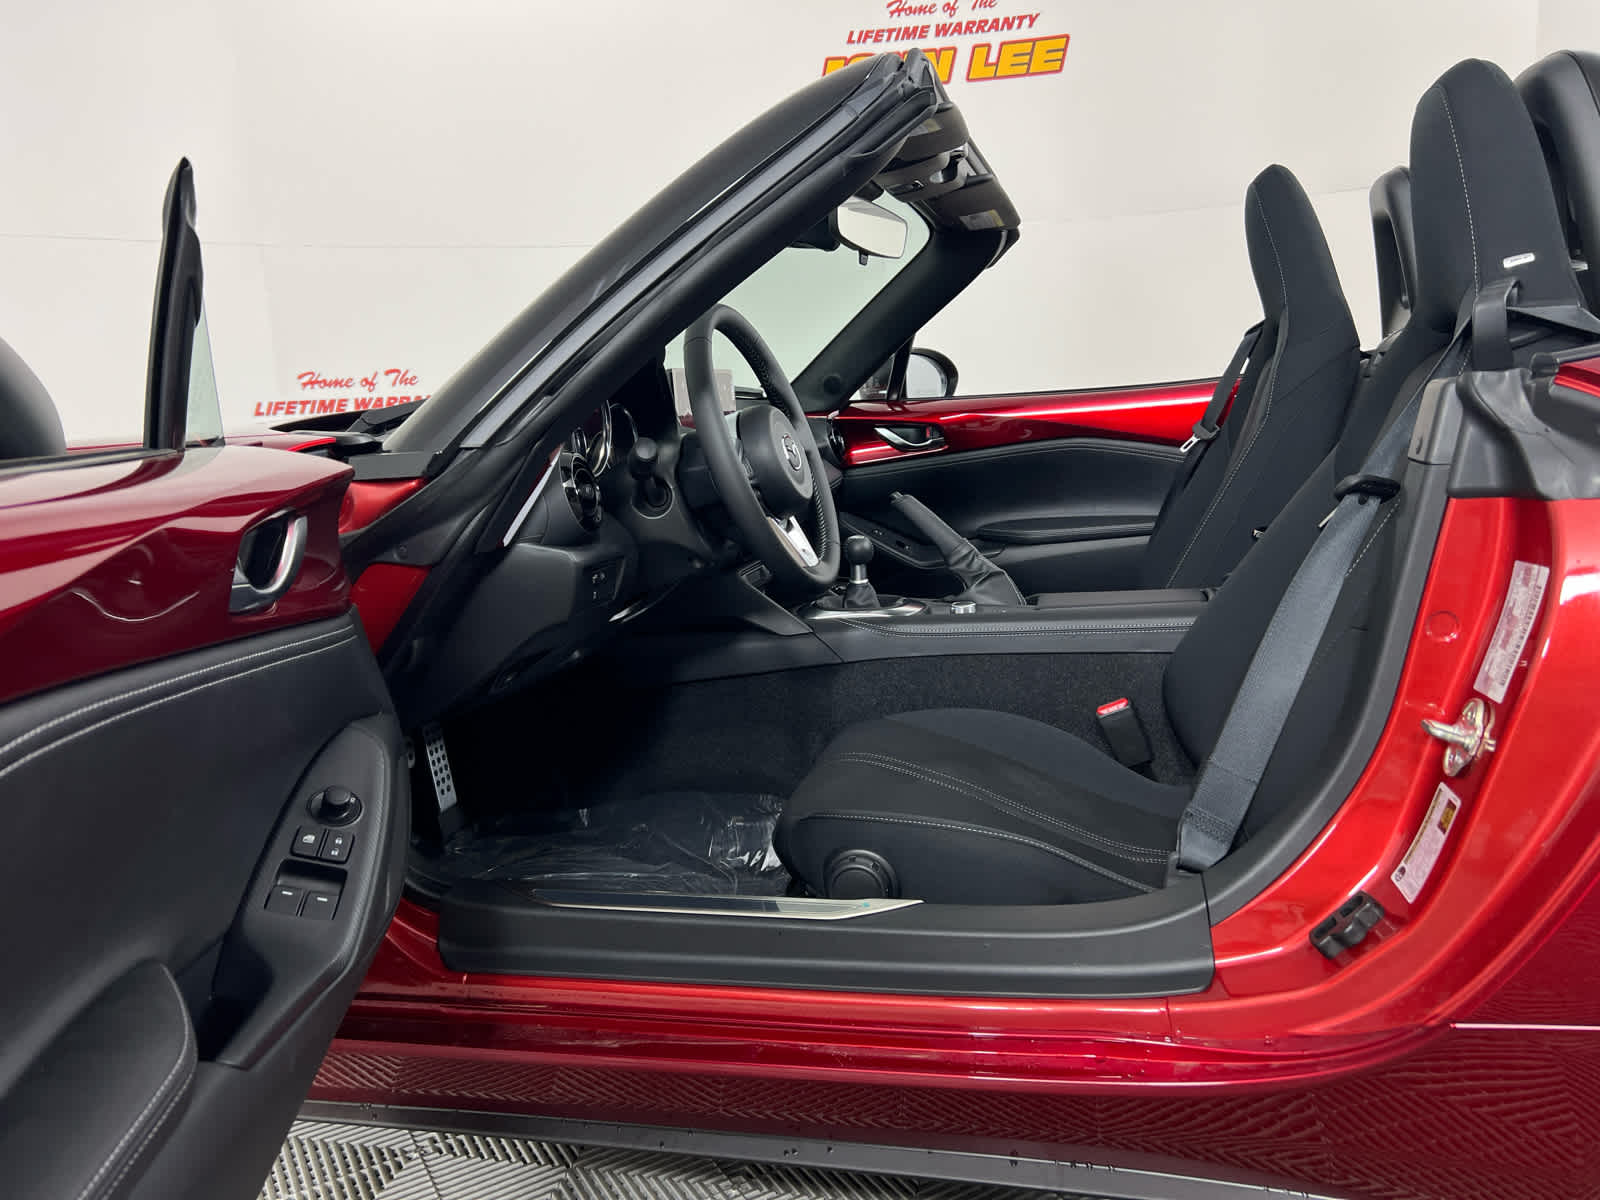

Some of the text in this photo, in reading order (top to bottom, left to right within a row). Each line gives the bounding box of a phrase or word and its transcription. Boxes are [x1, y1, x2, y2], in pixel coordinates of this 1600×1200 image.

[886, 0, 937, 18] Home
[942, 0, 959, 17] of
[846, 13, 1040, 45] LIFETIME WARRANTY
[966, 34, 1070, 83] LEE
[297, 368, 418, 392] Home of The
[254, 398, 350, 417] LIFETIME
